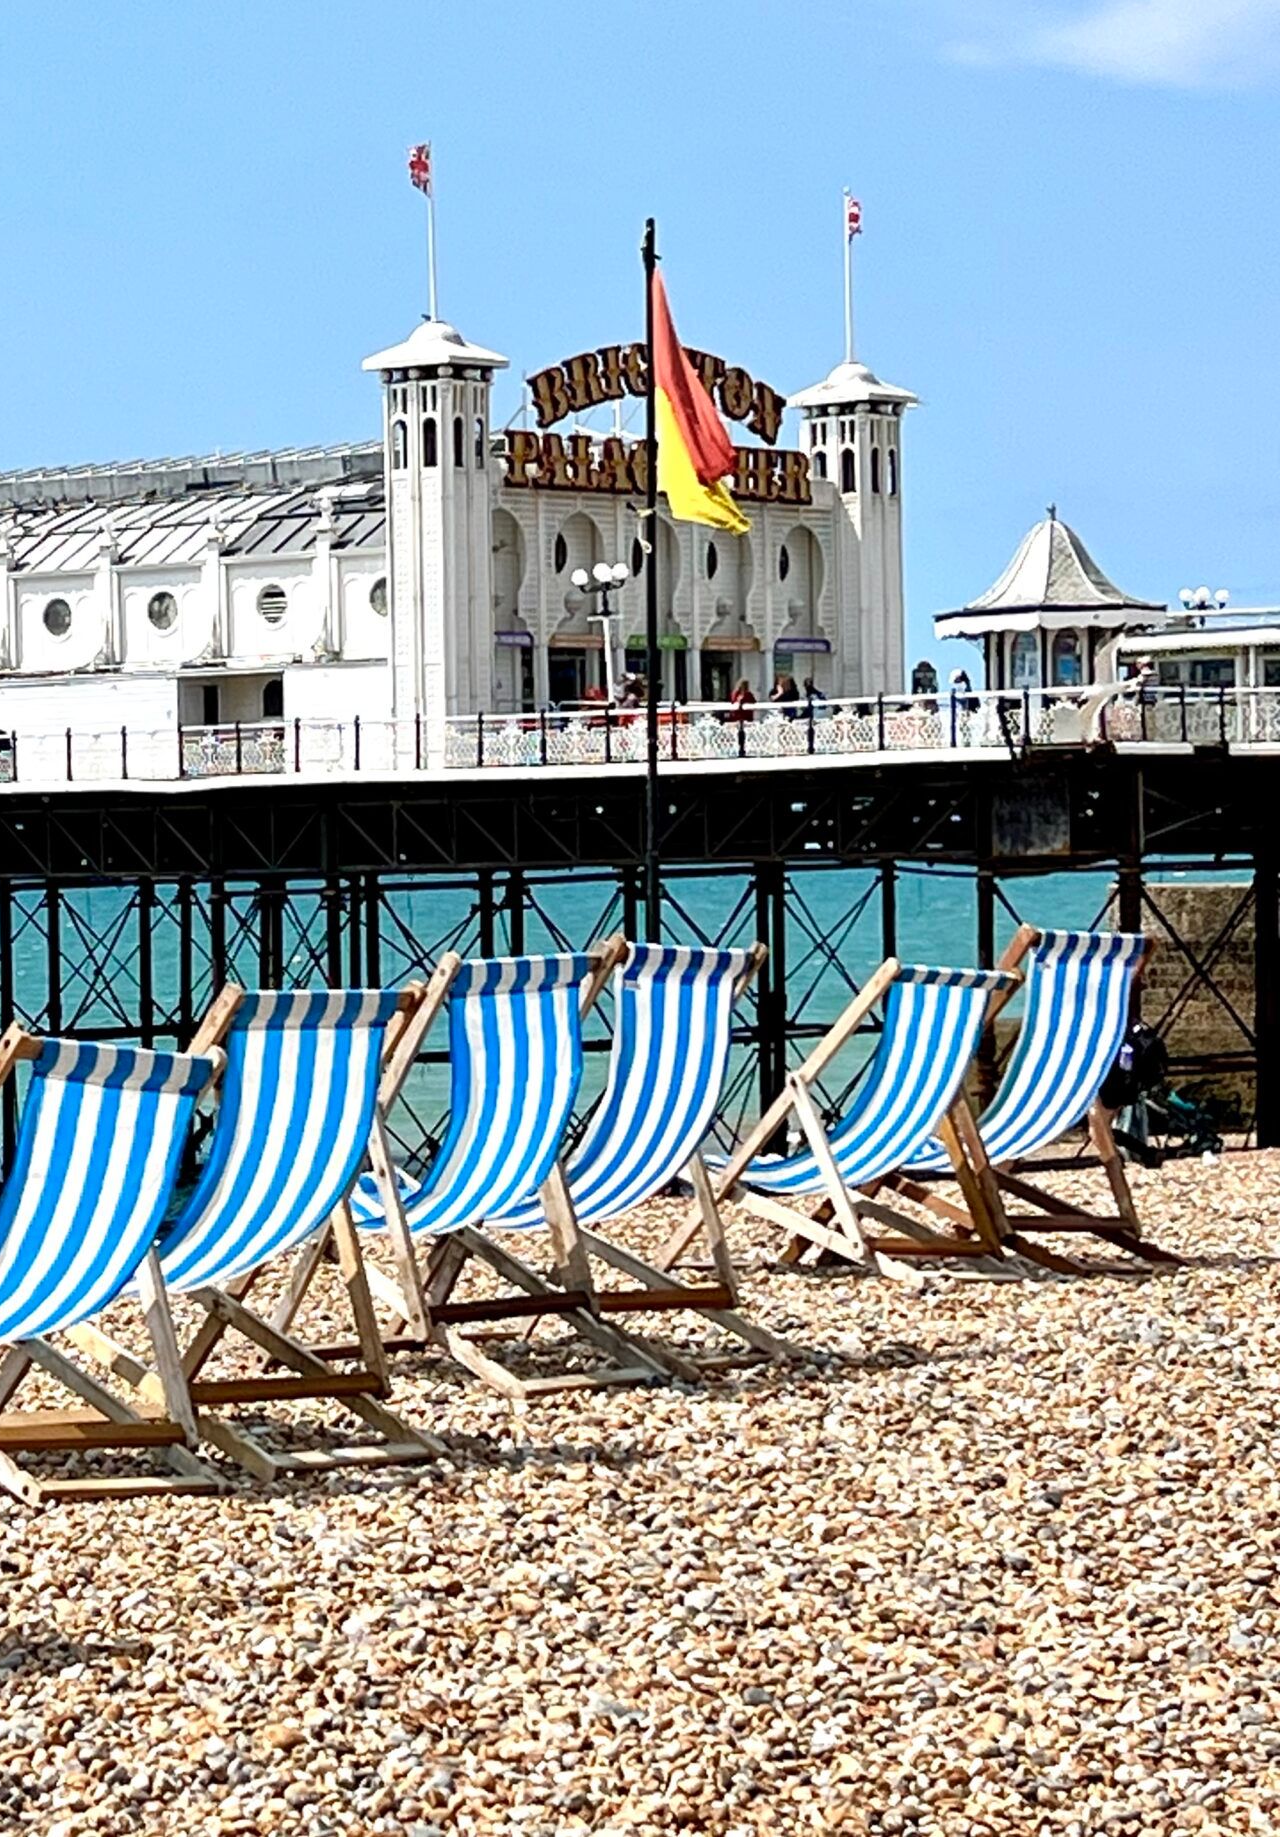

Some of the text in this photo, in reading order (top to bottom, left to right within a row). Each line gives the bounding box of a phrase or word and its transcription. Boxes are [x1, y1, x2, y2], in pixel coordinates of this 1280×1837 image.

[526, 343, 786, 445] BRIGTON
[504, 430, 812, 505] PALAC IER
